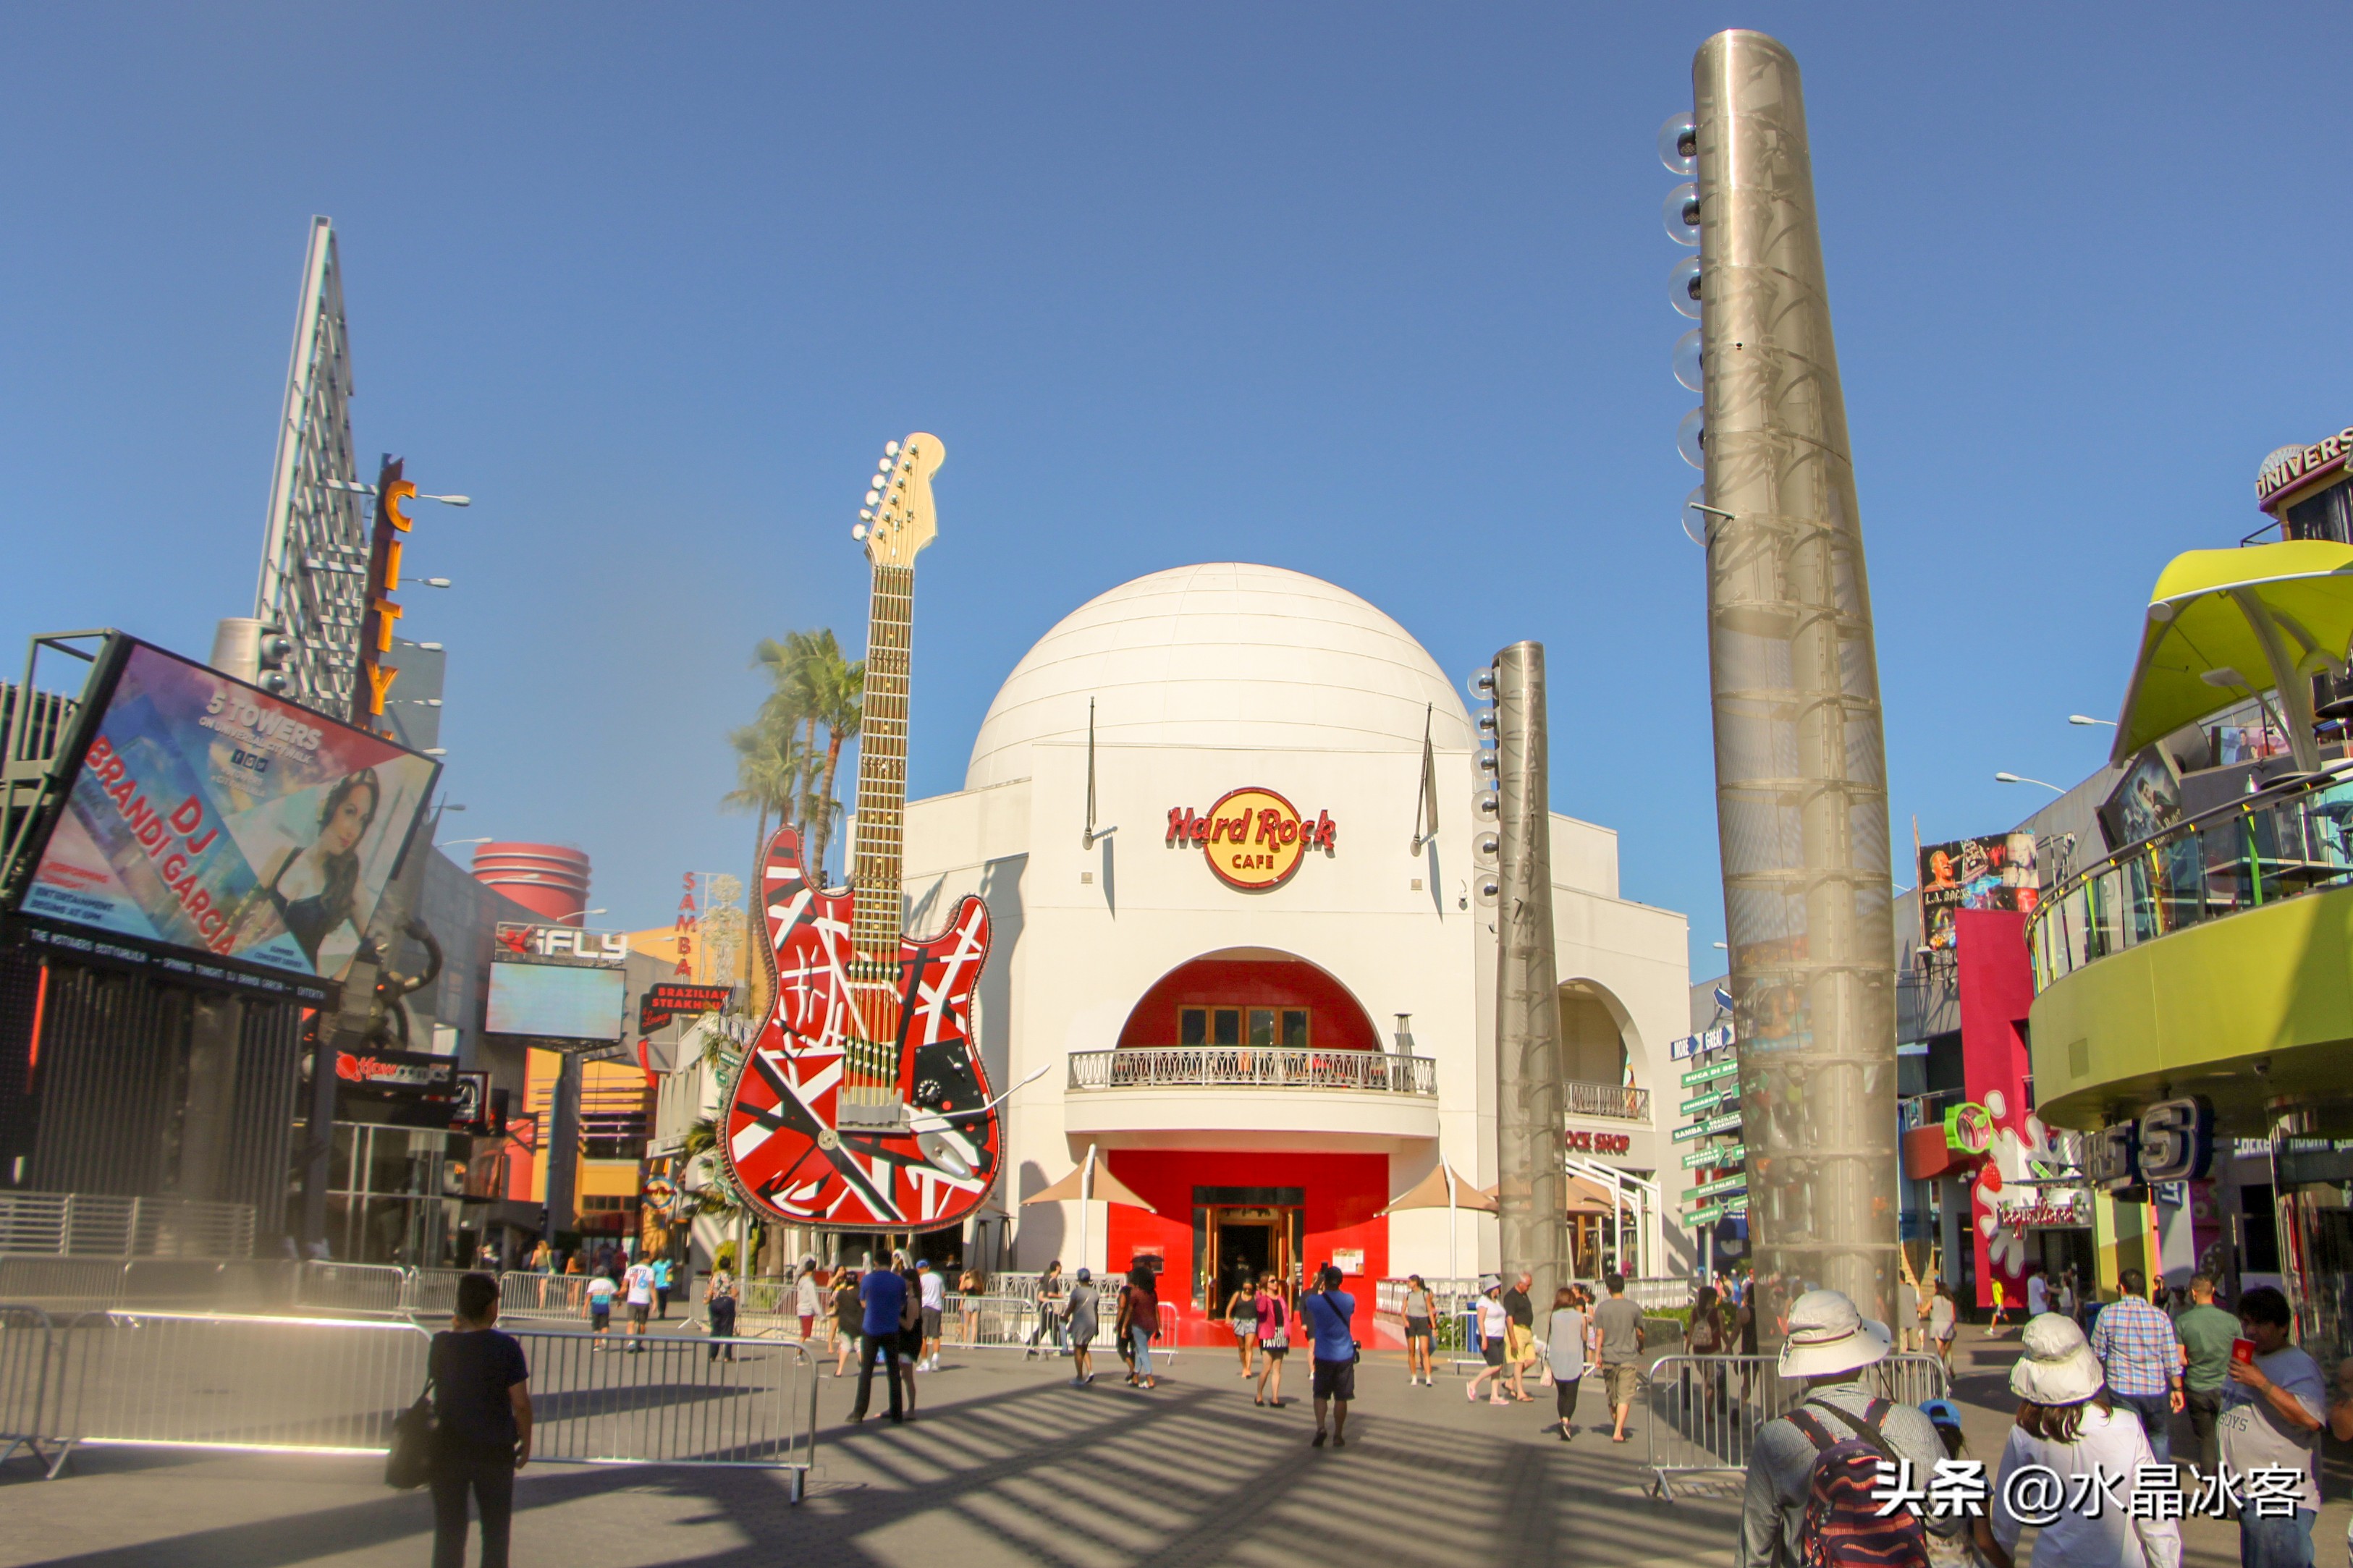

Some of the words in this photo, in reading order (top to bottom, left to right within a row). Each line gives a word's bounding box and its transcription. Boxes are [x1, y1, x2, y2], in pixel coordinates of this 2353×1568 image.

[206, 690, 227, 715] 5
[228, 698, 324, 750] TOWERS
[266, 741, 314, 764] CITYWALK
[169, 793, 219, 856] DJ
[1166, 806, 1253, 844] Hard
[1256, 808, 1336, 850] Rock
[85, 734, 172, 859] BRANDI
[162, 853, 237, 956] GARCIA
[1232, 854, 1274, 869] CAFE
[1925, 891, 1943, 905] L.A.
[674, 871, 696, 976] SAMBA
[658, 986, 729, 999] BRAZILIAN
[652, 999, 721, 1011] STEAKHOU
[1674, 1038, 1689, 1059] MORE
[1705, 1027, 1723, 1050] GREAT
[1686, 1071, 1708, 1082] BUCA
[1710, 1067, 1720, 1076] DI
[1723, 1063, 1738, 1072] BEP
[1683, 1095, 1719, 1110] CINNABON
[1707, 1119, 1743, 1132] STEAKHOUS
[1709, 1114, 1739, 1126] BRAZILIAN
[1674, 1126, 1702, 1139] SAMBA
[1563, 1130, 1592, 1150] OCK
[1594, 1133, 1630, 1153] SHOP
[1686, 1154, 1720, 1166] PRETZELS
[1698, 1186, 1714, 1195] SHOE
[1715, 1179, 1736, 1190] PALACE
[1689, 1211, 1719, 1222] RAIDERS
[629, 1273, 648, 1290] 76
